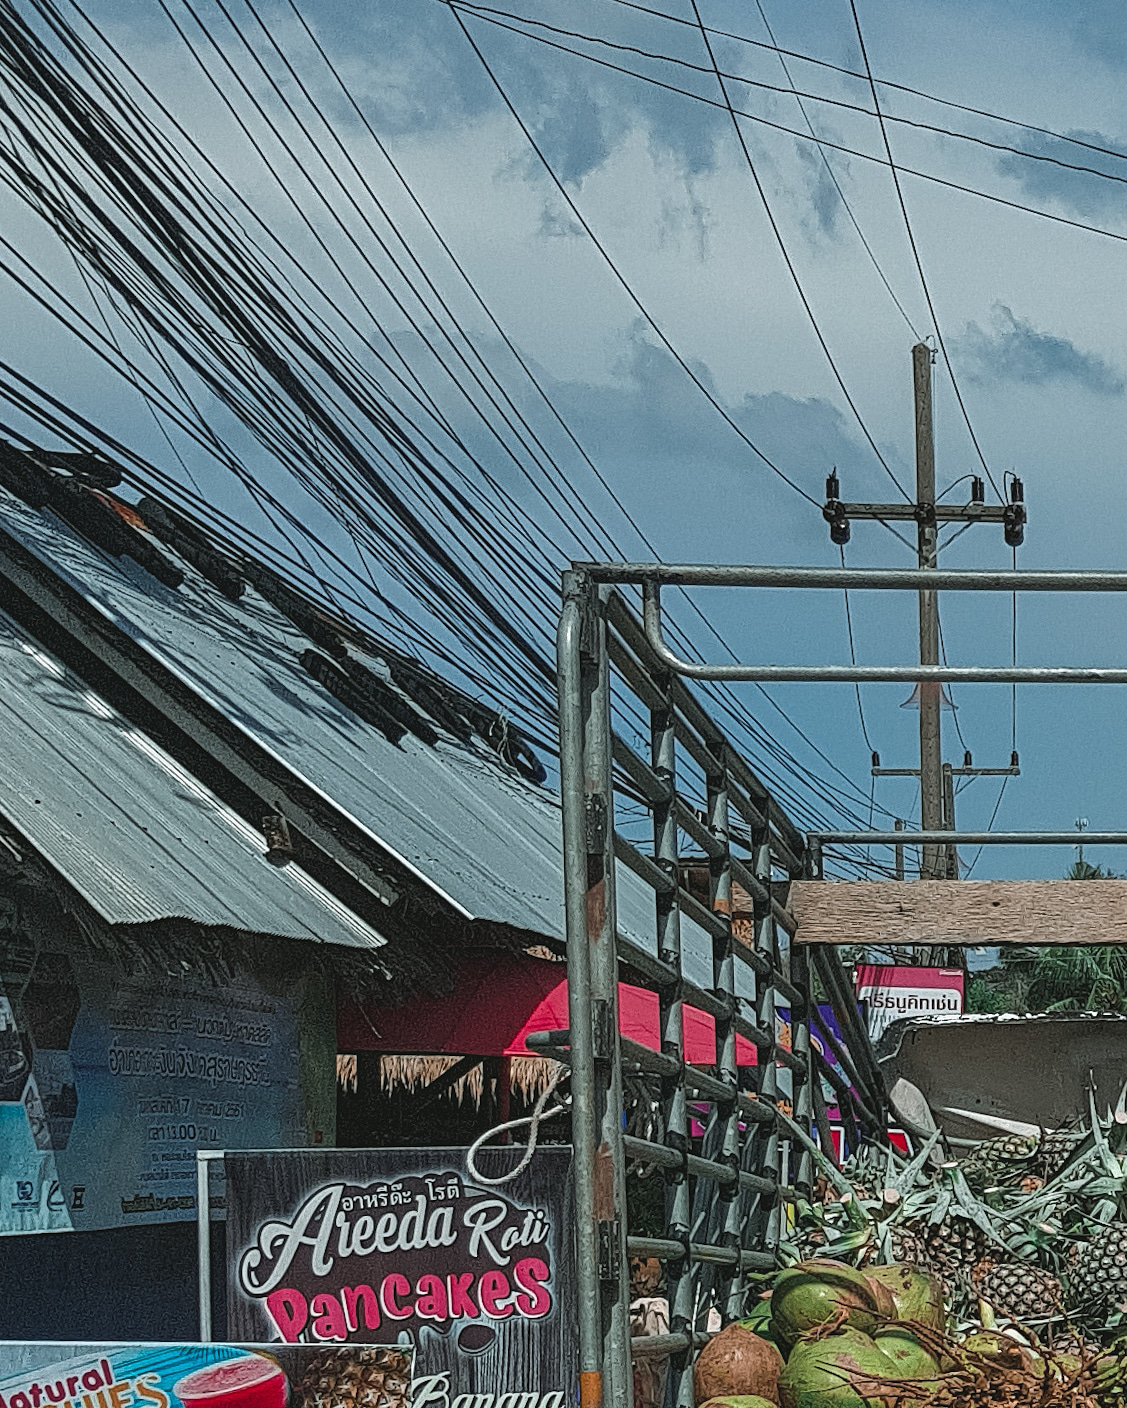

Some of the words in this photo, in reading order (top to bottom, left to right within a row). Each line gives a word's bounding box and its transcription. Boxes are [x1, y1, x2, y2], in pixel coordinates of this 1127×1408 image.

[424, 1177, 460, 1201] โรตี
[242, 1185, 458, 1293] Areeda
[464, 1200, 550, 1266] Roti
